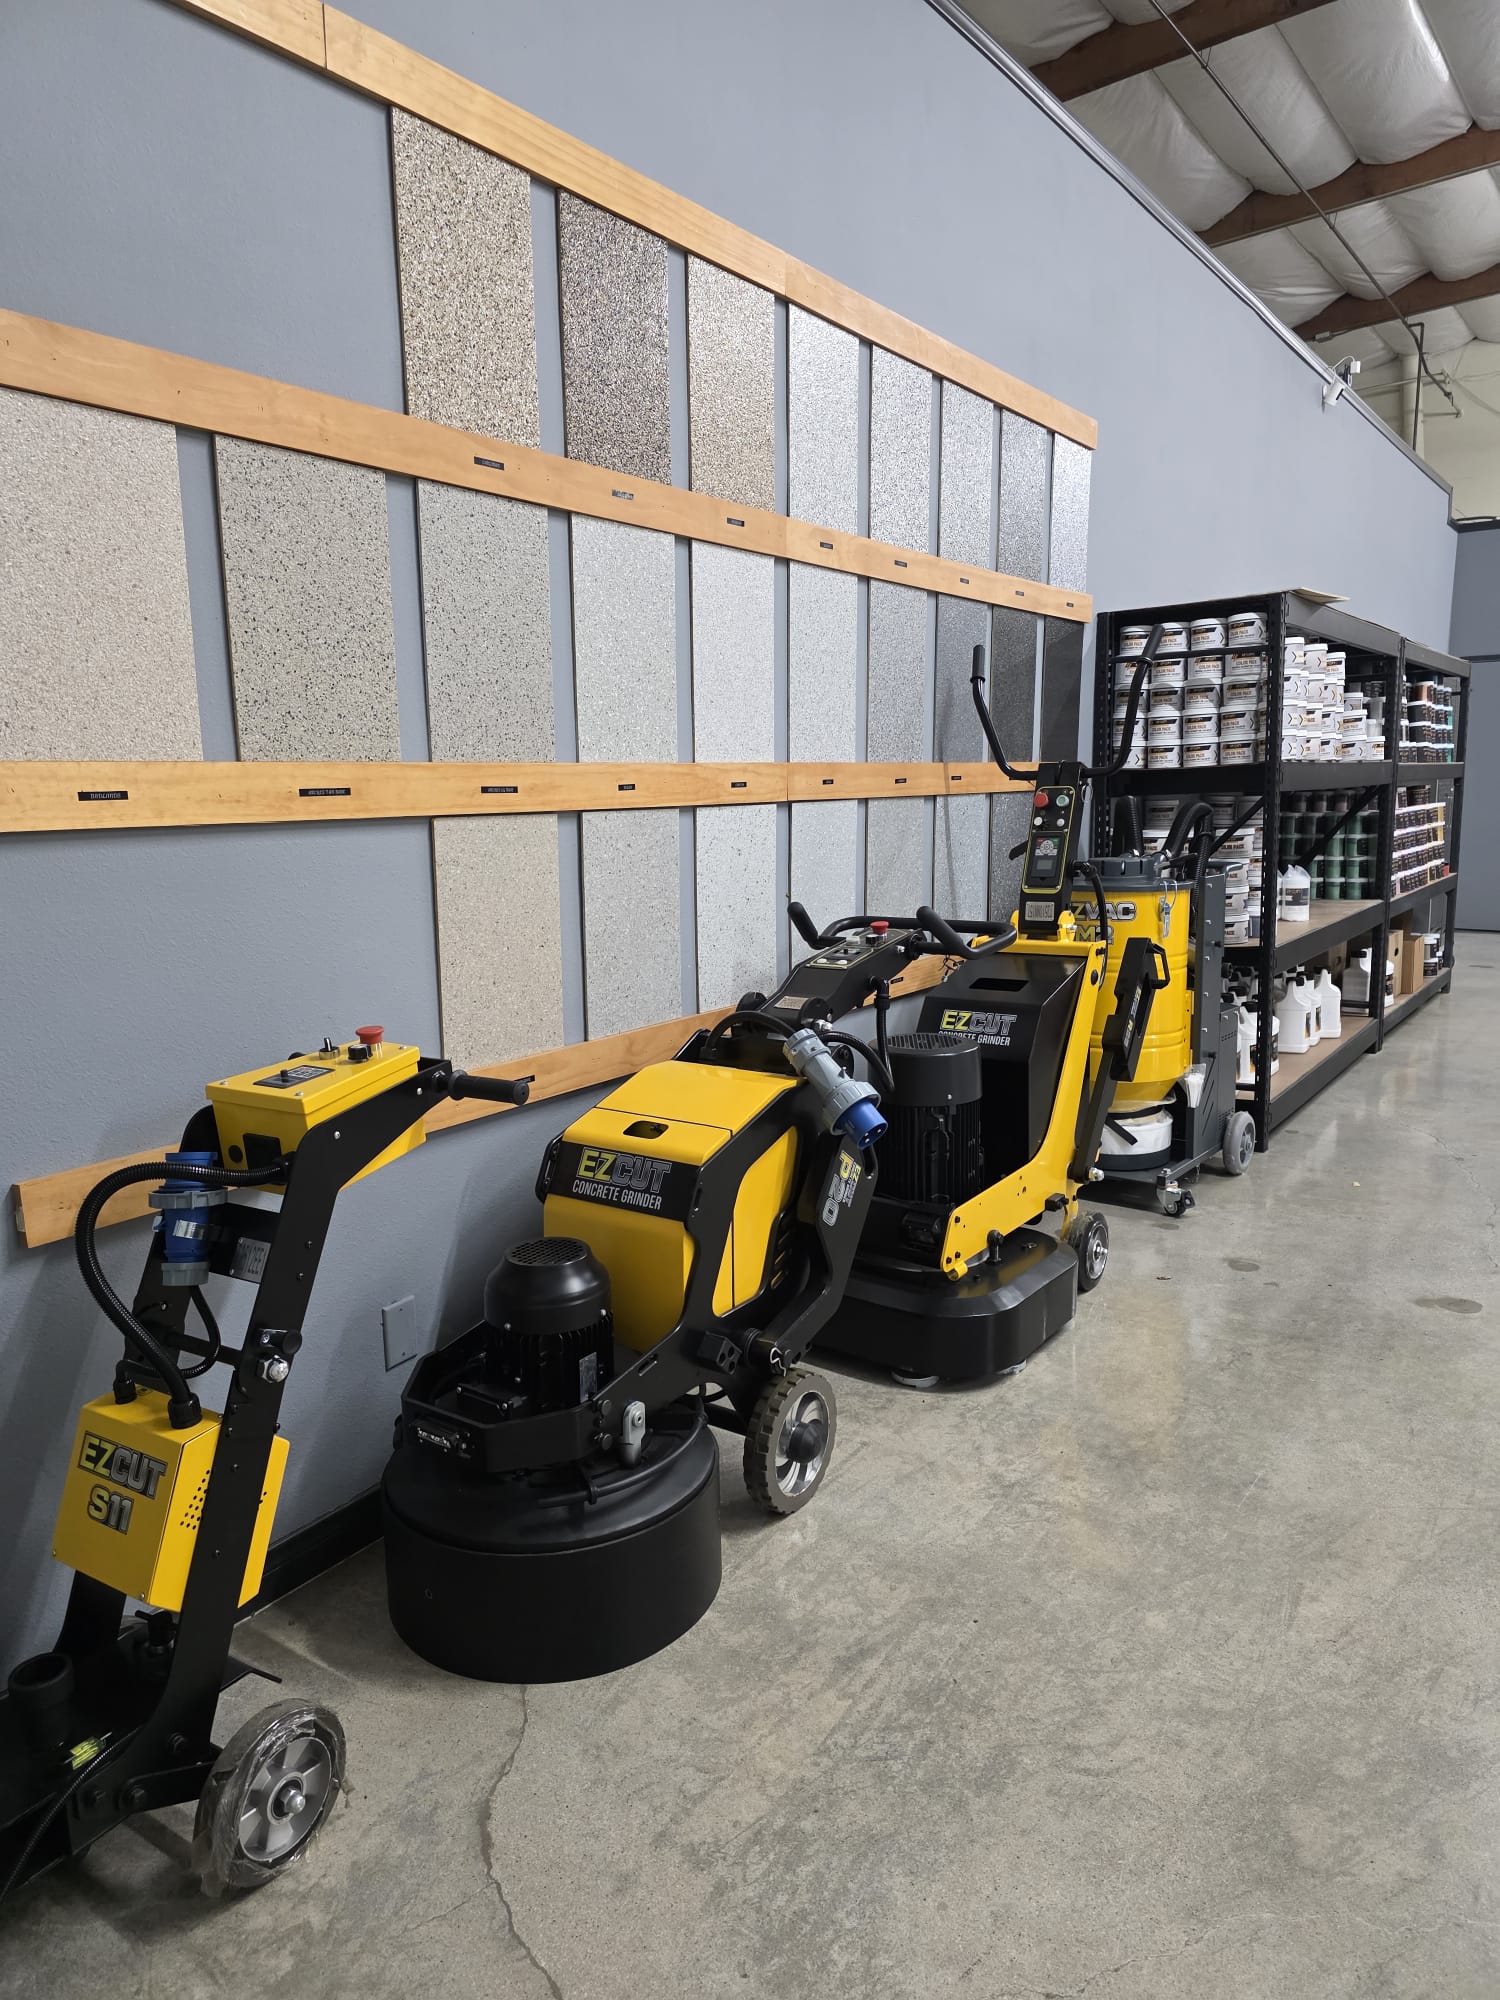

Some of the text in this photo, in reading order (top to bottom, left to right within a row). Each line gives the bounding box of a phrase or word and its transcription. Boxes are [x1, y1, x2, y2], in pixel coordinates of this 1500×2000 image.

[939, 1009, 1018, 1036] EZCUT
[976, 1034, 1011, 1047] GRINDER
[576, 1146, 673, 1194] EZCUT
[572, 1179, 662, 1211] CONCRETE GRINDER
[78, 1430, 169, 1501] EZCUT
[87, 1483, 135, 1536] S11
